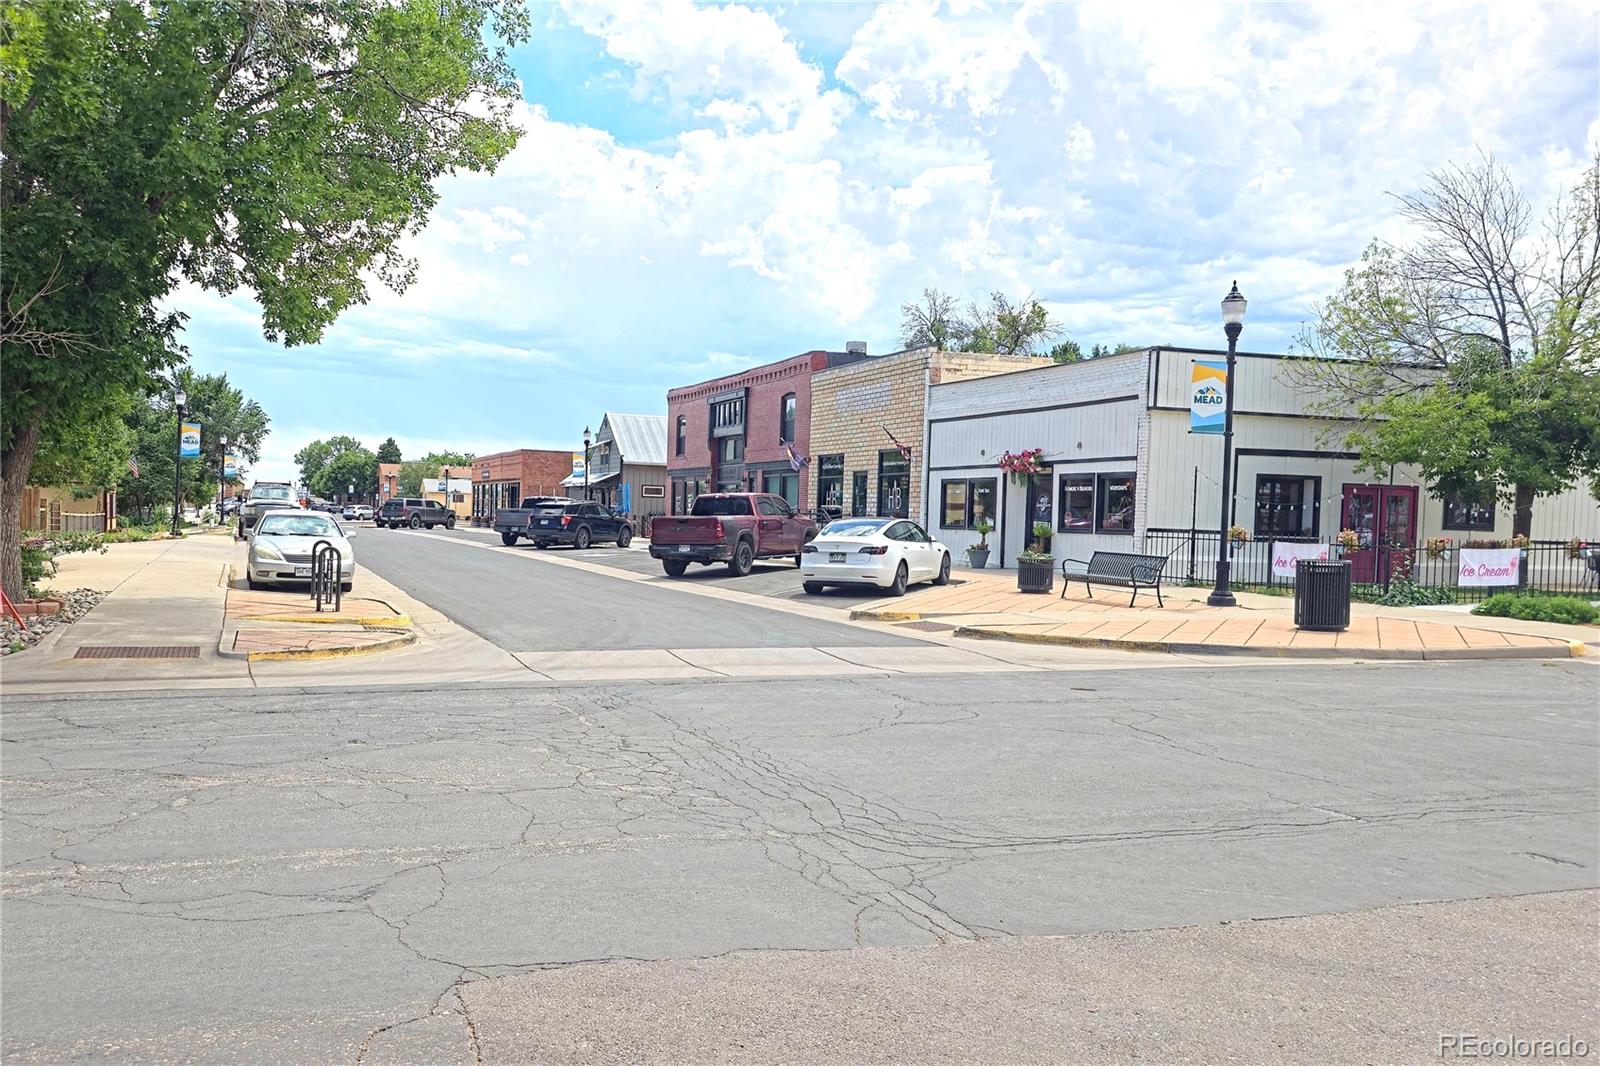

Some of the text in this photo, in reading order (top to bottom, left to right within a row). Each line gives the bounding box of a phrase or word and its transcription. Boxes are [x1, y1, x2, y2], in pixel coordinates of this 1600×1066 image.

[1194, 395, 1223, 404] MEAD
[1275, 556, 1288, 567] Ice
[1460, 563, 1510, 577] Ice Cream
